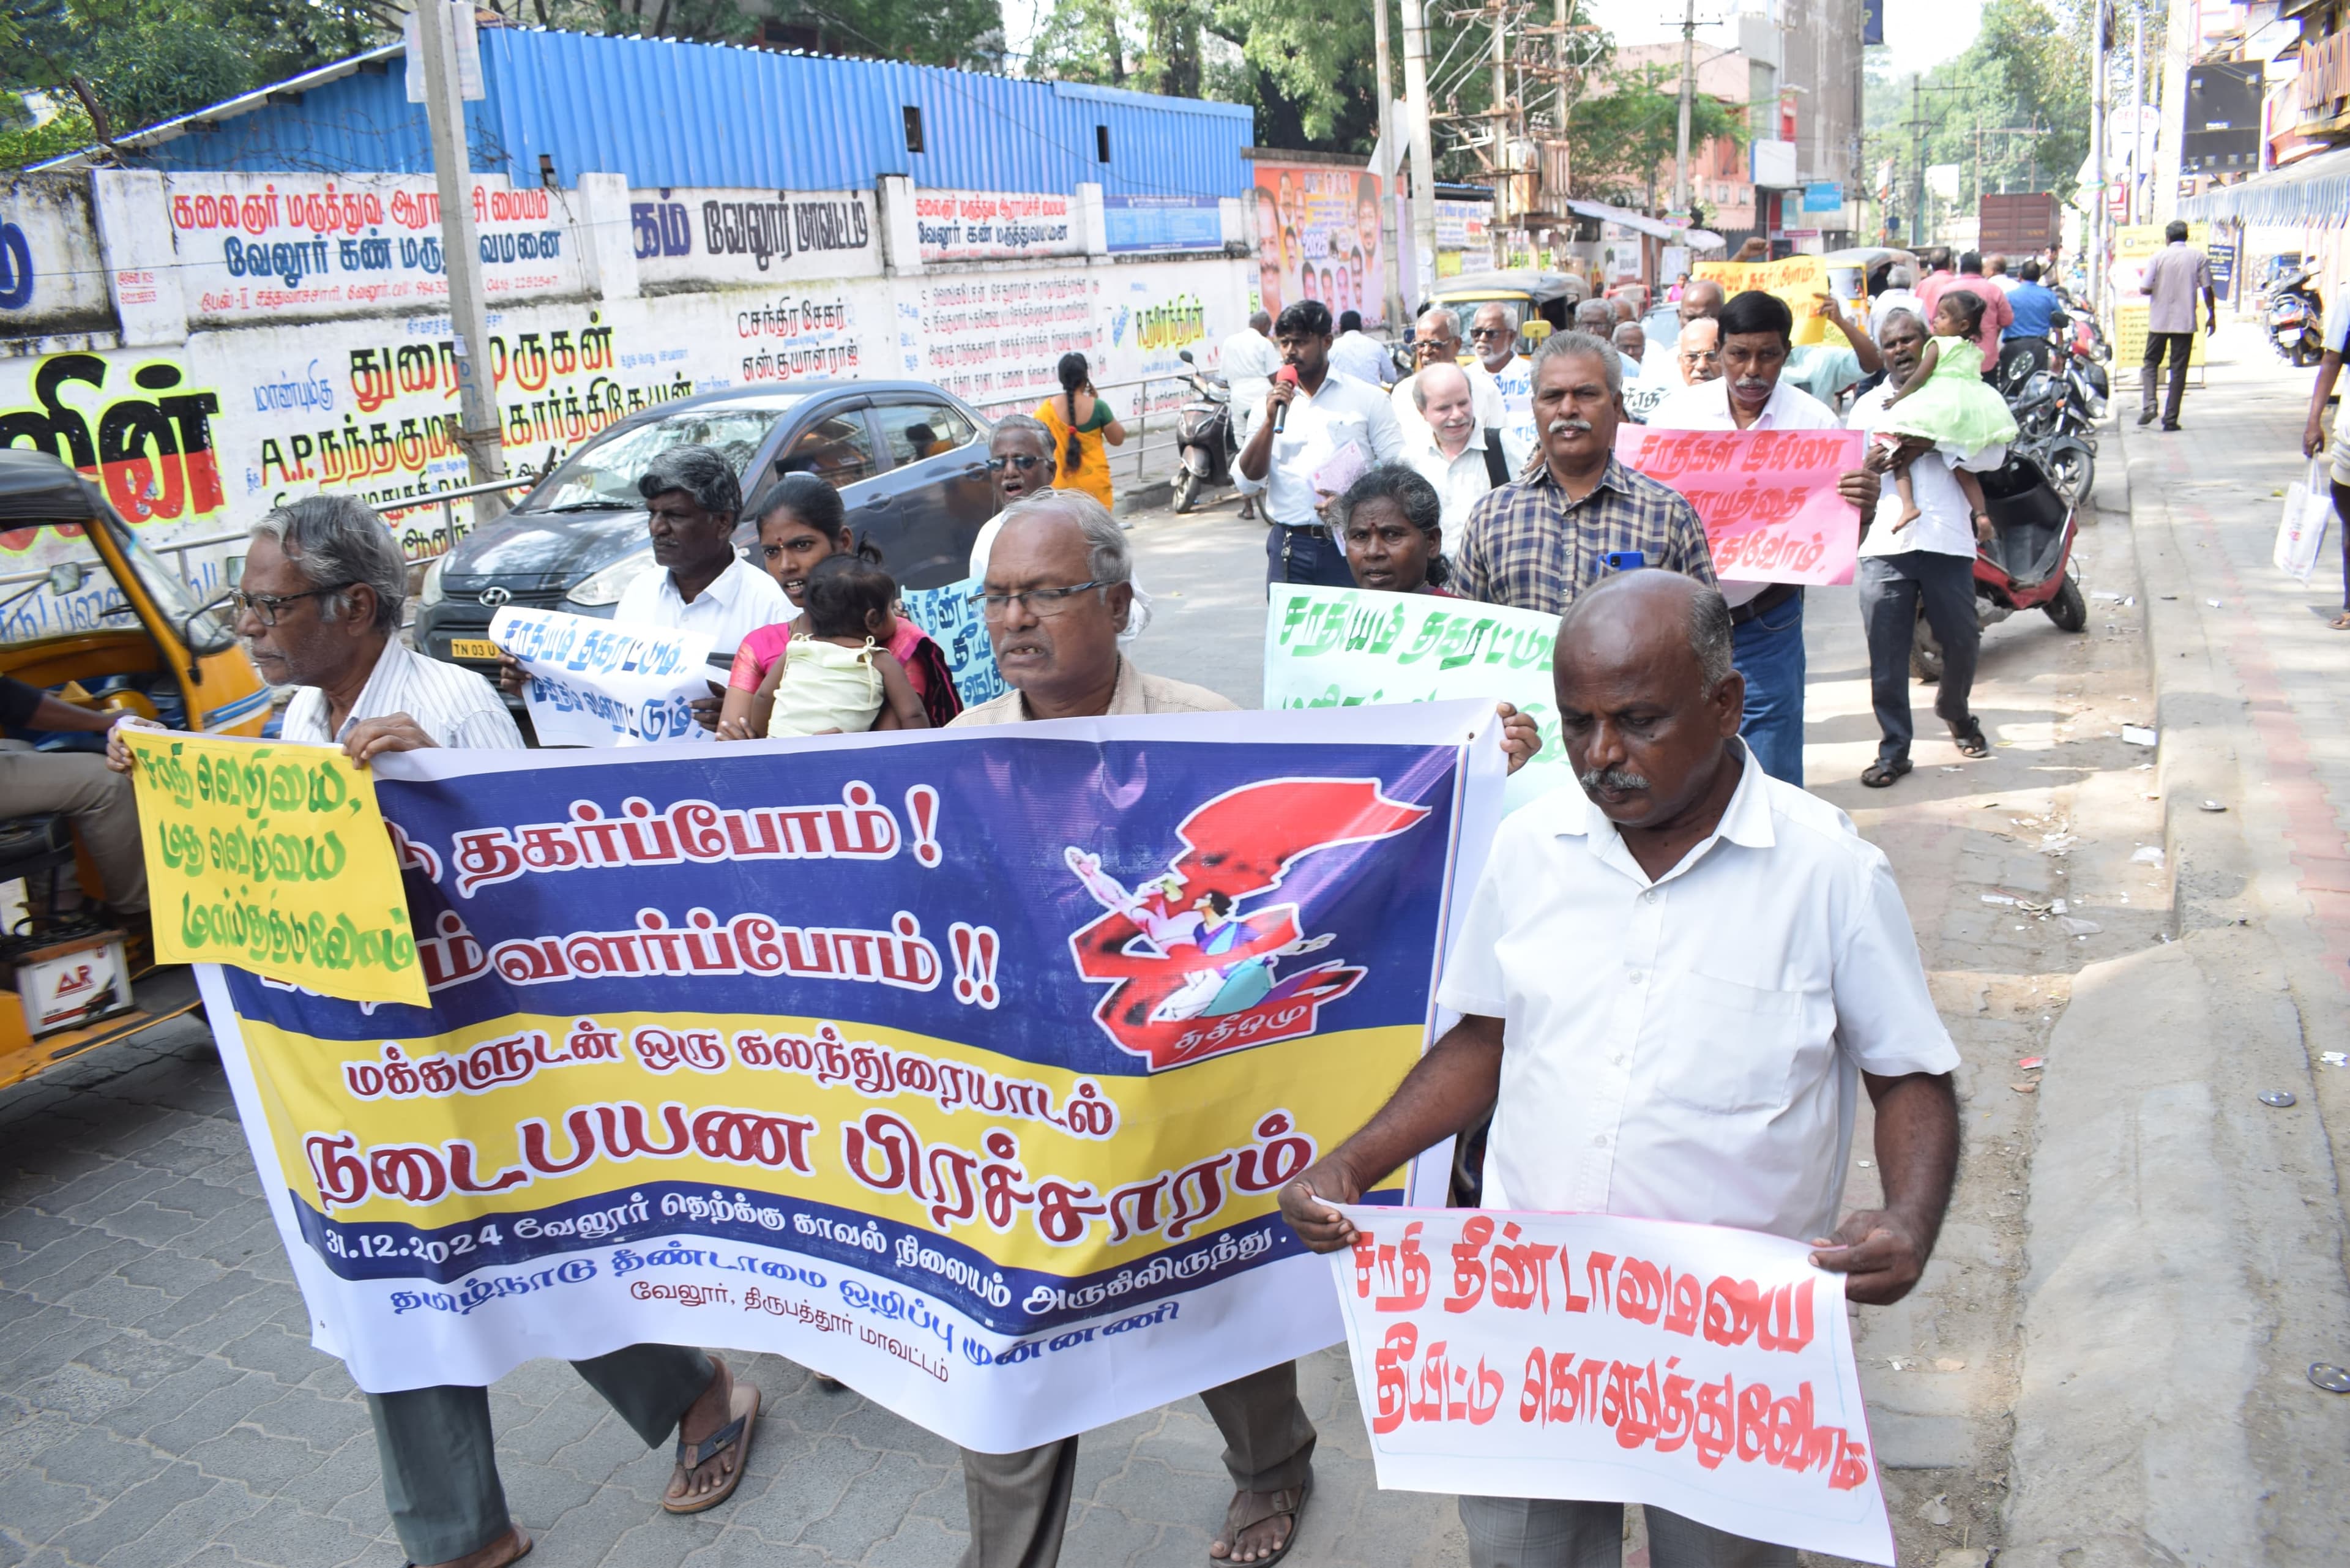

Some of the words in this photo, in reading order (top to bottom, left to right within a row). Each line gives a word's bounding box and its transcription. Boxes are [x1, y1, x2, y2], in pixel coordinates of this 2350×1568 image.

[174, 183, 278, 234] கலைஞர்
[286, 182, 382, 235] மருத்துவ
[491, 187, 548, 222] மையம்
[703, 190, 791, 271] வேலூர்
[793, 188, 869, 252] மாவட்டம்
[918, 220, 961, 250] வேலூர்
[967, 222, 992, 243] கண்
[225, 234, 328, 288] வேலூர்
[339, 227, 392, 271] கண்
[1302, 231, 1329, 259] 2025
[253, 359, 333, 413] மாண்புமிகு
[1633, 431, 1744, 480] சாதிகள்
[453, 644, 469, 655] TN
[472, 644, 484, 657] 03
[1279, 591, 1406, 657] சாதியம்
[136, 742, 194, 809] சாதி
[159, 819, 204, 878] மத
[209, 818, 348, 883] வெறியை
[346, 1020, 617, 1096] மக்களுடன்
[635, 1028, 726, 1071] ஒரு
[738, 1026, 1114, 1136] கலந்துரையாடல்
[846, 1113, 1311, 1242] பிரச்சாரம்
[326, 1224, 503, 1264] 31.12.2024
[513, 1192, 649, 1239] வேலூர்
[794, 1212, 887, 1253] காவல்
[895, 1235, 1012, 1307] நிலையம்
[390, 1258, 598, 1315] தமிழ்நாடு
[612, 1240, 828, 1288] தீண்டாமை
[840, 1279, 953, 1354] ஒழிப்பு
[963, 1301, 1180, 1366] முன்னணி
[1353, 1221, 1433, 1313] சாதி
[1443, 1215, 1816, 1354] தீண்டாமையை
[630, 1280, 736, 1306] வேலூர்,
[744, 1286, 854, 1333] திருபத்தூர்
[860, 1324, 949, 1383] மாவட்டம்
[1372, 1321, 1505, 1435] தீயிட்டு
